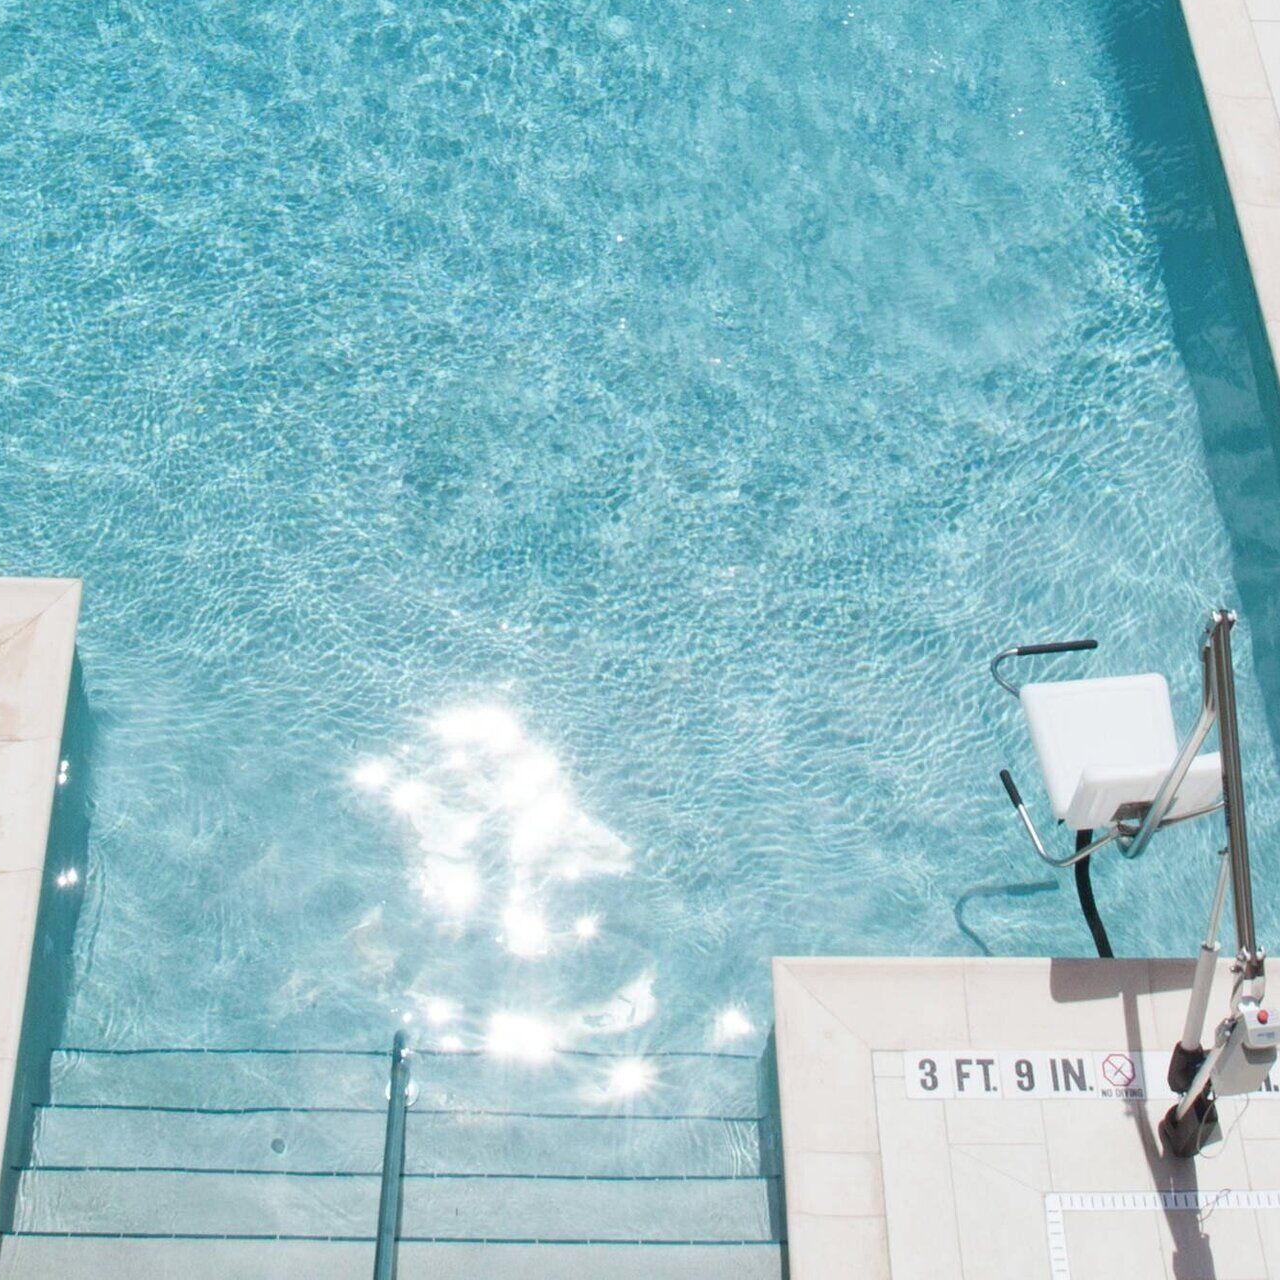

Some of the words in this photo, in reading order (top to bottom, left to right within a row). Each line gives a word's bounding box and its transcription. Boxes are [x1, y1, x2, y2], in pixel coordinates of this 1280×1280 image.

[918, 1058, 939, 1092] 3
[955, 1058, 998, 1093] FT.
[1014, 1058, 1036, 1092] 9
[1049, 1057, 1095, 1093] IN.
